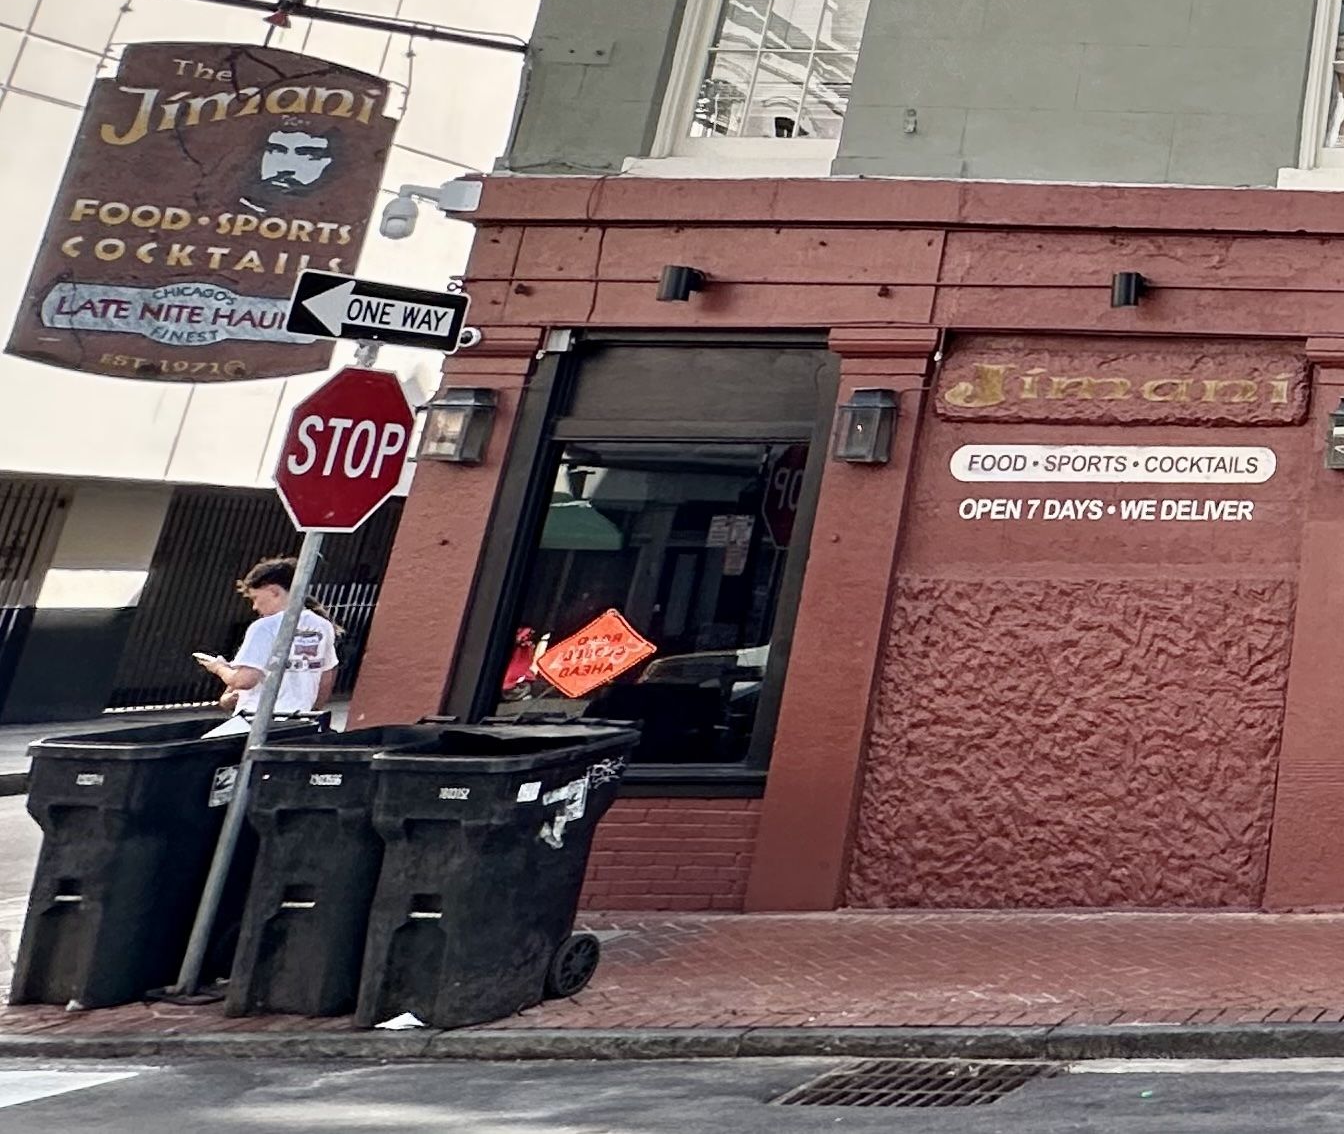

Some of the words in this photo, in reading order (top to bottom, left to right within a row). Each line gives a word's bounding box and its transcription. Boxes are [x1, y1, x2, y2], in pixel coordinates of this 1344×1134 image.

[172, 58, 232, 83] The
[101, 86, 381, 146] Jimani
[69, 199, 192, 231] FOOD
[215, 212, 351, 245] SPORTS
[54, 295, 131, 320] LATE
[139, 301, 205, 325] NITE
[347, 298, 396, 325] ONE
[401, 306, 449, 332] WAY
[151, 326, 219, 342] FINEST
[944, 364, 1293, 409] Jimani
[287, 415, 406, 479] STOP
[968, 454, 1027, 472] FOOD
[1044, 454, 1128, 473] SPORTS
[1144, 456, 1259, 474] COCKTAILS
[959, 498, 1022, 521] OPEN
[1027, 499, 1041, 521] 7
[1043, 499, 1104, 521] DAYS
[1120, 500, 1158, 521] WE
[1160, 500, 1255, 522] DELIVER
